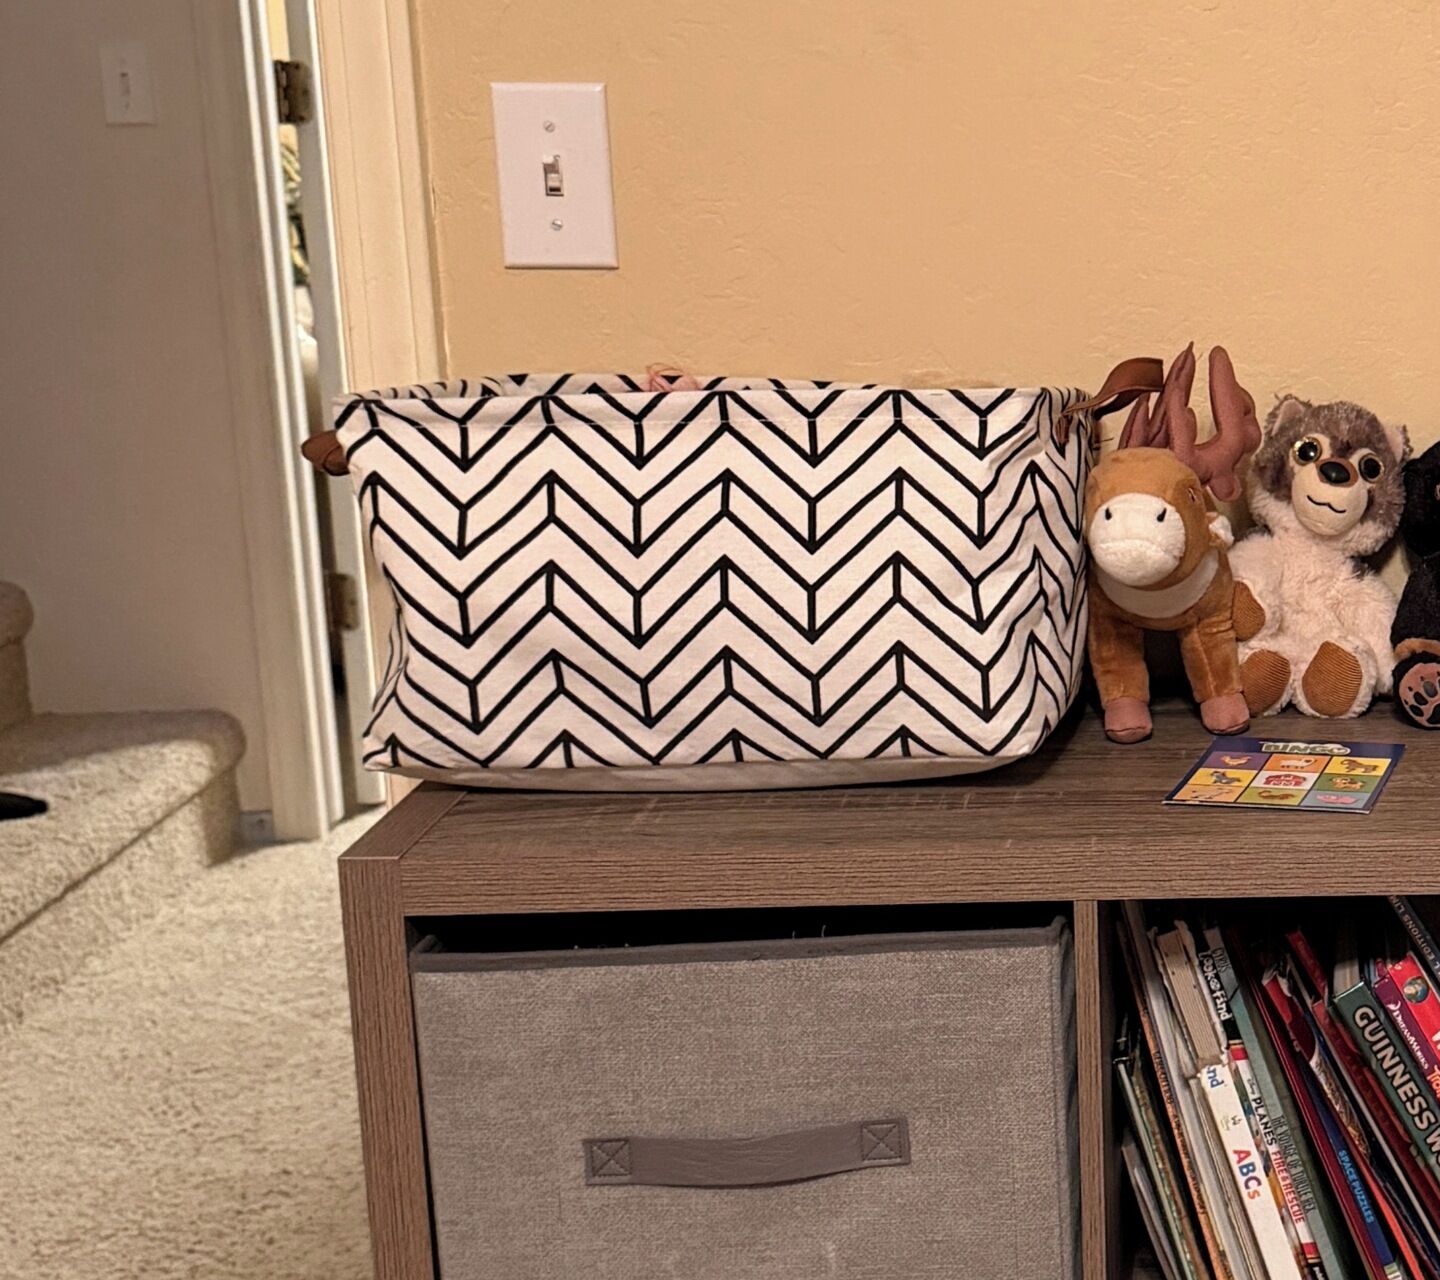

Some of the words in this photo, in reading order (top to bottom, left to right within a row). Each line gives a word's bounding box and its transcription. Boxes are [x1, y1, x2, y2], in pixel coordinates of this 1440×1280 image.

[1262, 743, 1350, 755] BINGO
[1405, 915, 1435, 964] EDITIONS
[1354, 1005, 1436, 1131] GUINNESS
[1271, 1115, 1288, 1136] THE
[1277, 1133, 1300, 1162] VOYAGE
[1233, 1149, 1262, 1200] ABCs
[1252, 1097, 1278, 1147] PLANES
[1271, 1150, 1289, 1176] FIRE
[1283, 1181, 1306, 1225] RESCUE
[1292, 1167, 1313, 1198] TURTLE
[1338, 1149, 1355, 1181] SPACE
[1349, 1179, 1375, 1224] PUZZLES
